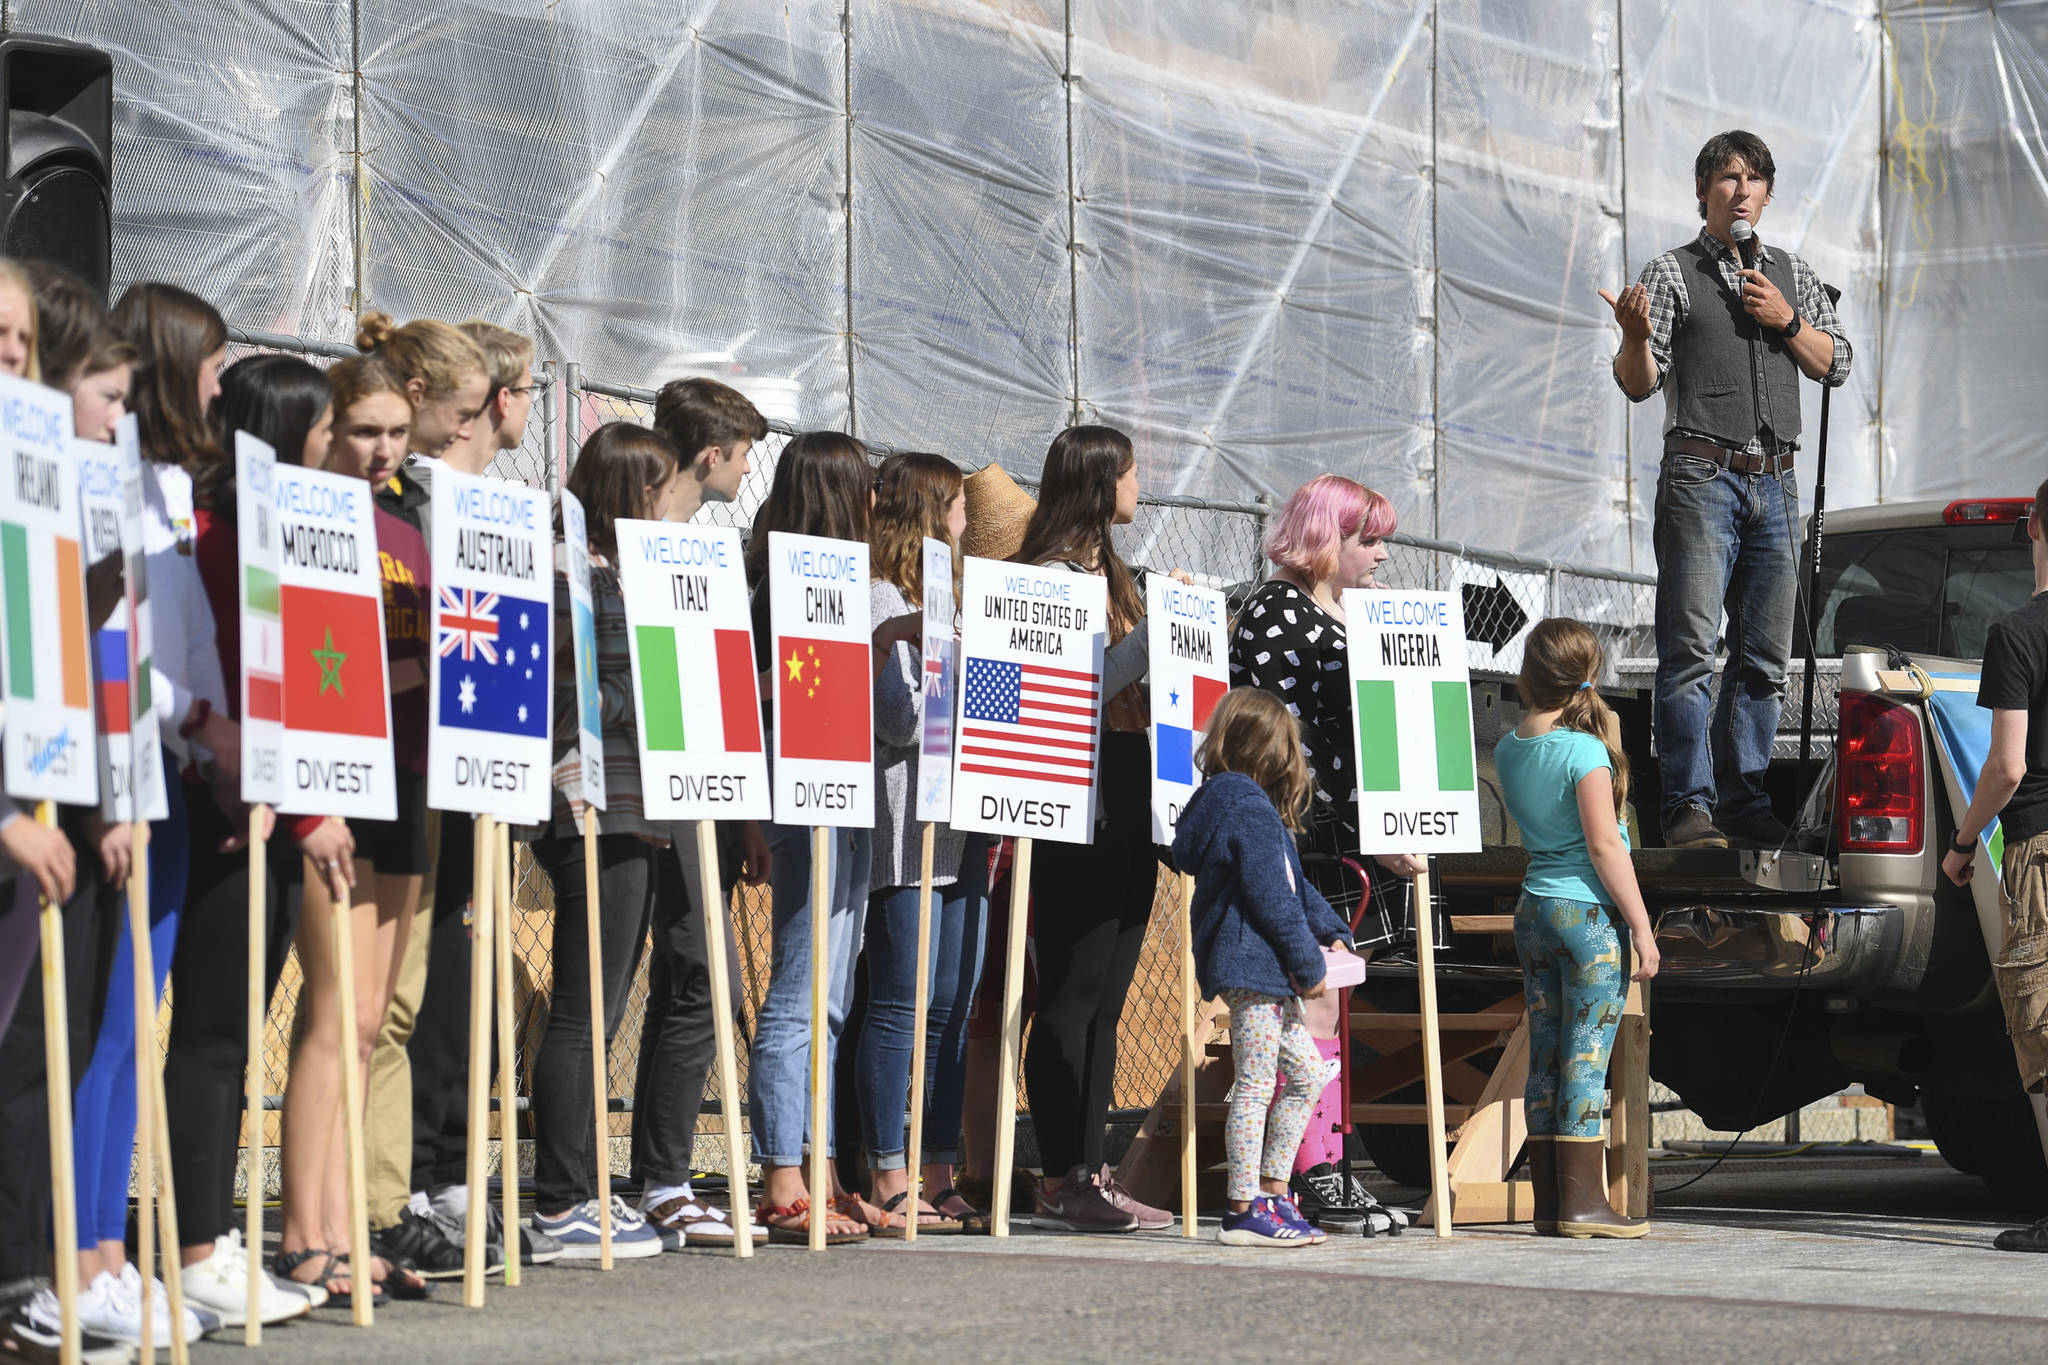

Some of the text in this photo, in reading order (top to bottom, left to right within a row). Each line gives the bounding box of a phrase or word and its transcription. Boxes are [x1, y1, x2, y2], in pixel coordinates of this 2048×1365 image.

[2, 397, 63, 452] WELCOME
[14, 450, 61, 512] IRELAND
[276, 479, 358, 524] WELCOME
[452, 484, 536, 531] WELCOME
[281, 522, 359, 575] MOROCCO
[456, 526, 535, 581] AUSTRALIA
[640, 535, 729, 569] WELCOME
[788, 550, 857, 583] WELCOME
[671, 574, 709, 612] ITALY
[805, 586, 845, 626] CHINA
[1005, 575, 1072, 602] WELCOME
[1161, 586, 1217, 625] WELCOME
[984, 594, 1028, 623] UNITED
[1031, 601, 1072, 629] STATES
[1074, 607, 1088, 632] OF
[1364, 599, 1448, 627] WELCOME
[1009, 626, 1063, 657] AMERICA
[1170, 621, 1214, 665] PANAMA
[1380, 632, 1442, 667] NIGERIA
[296, 758, 373, 795] DIVEST
[455, 756, 530, 793] DIVEST
[670, 774, 747, 803] DIVEST
[794, 781, 858, 811] DIVEST
[980, 795, 1072, 830] DIVEST
[1383, 810, 1460, 838] DIVEST
